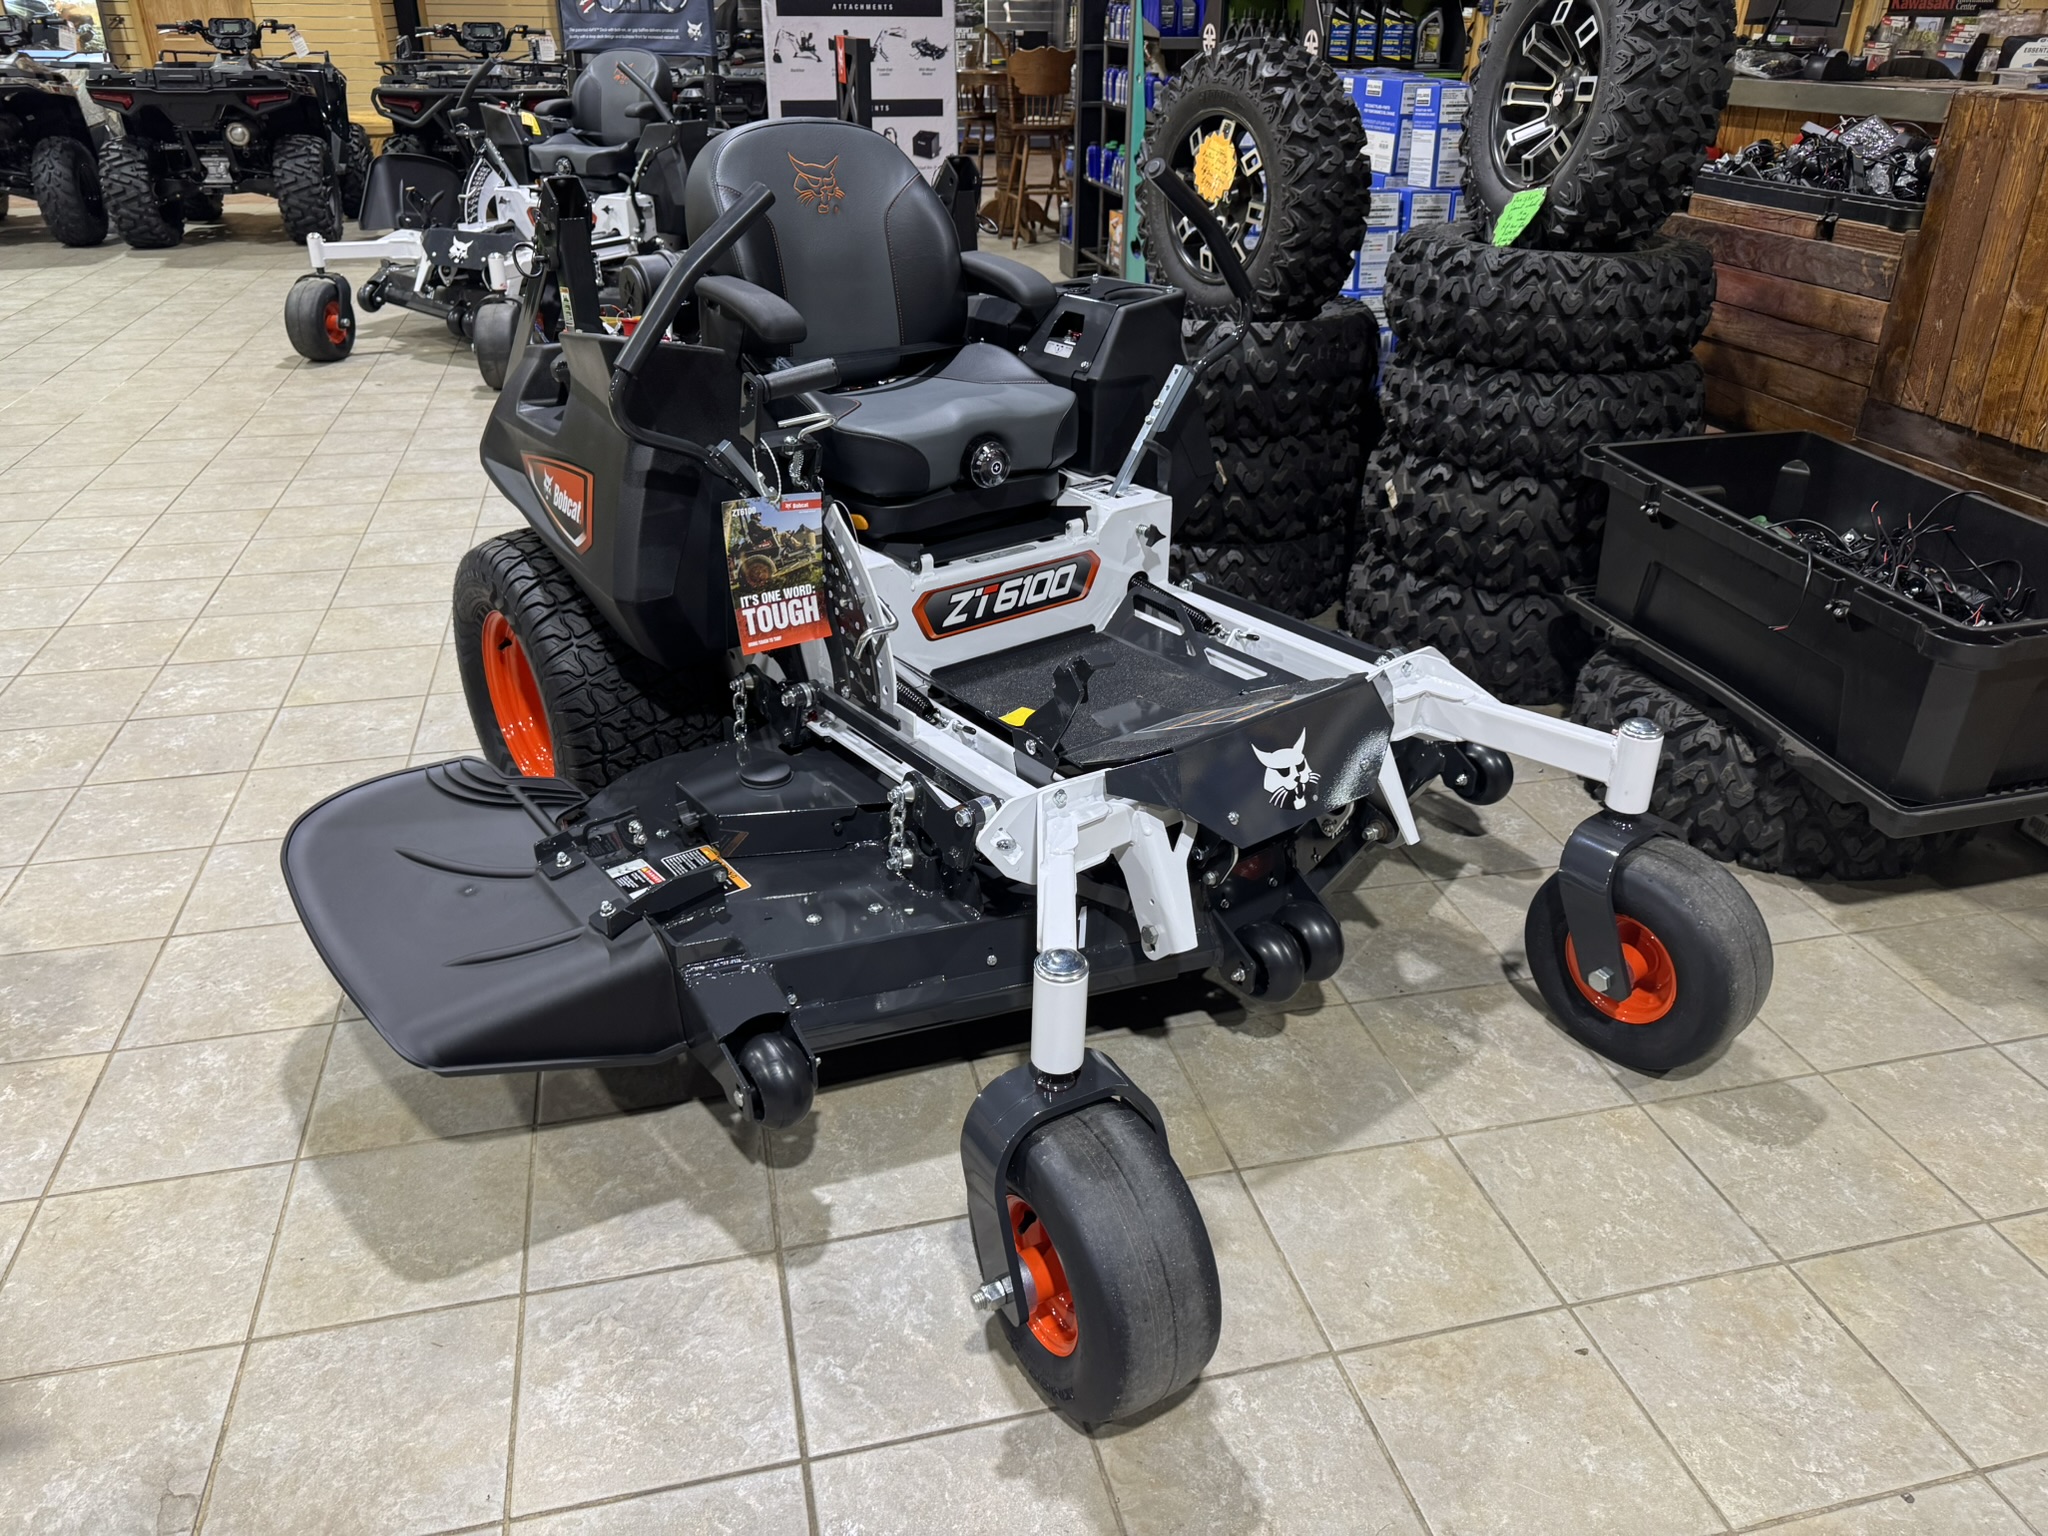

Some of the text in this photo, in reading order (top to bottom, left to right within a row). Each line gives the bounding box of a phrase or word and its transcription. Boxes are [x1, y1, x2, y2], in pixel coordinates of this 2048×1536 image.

[832, 3, 894, 11] ATTACHMENTS
[1891, 0, 1955, 10] Kawasaki
[1955, 3, 1977, 11] Center
[553, 483, 582, 524] Bobcat
[732, 506, 757, 517] ZT6100
[740, 583, 816, 608] IT'S ONE WORD:
[942, 563, 1078, 628] ZT6100
[742, 595, 821, 636] TOUGH
